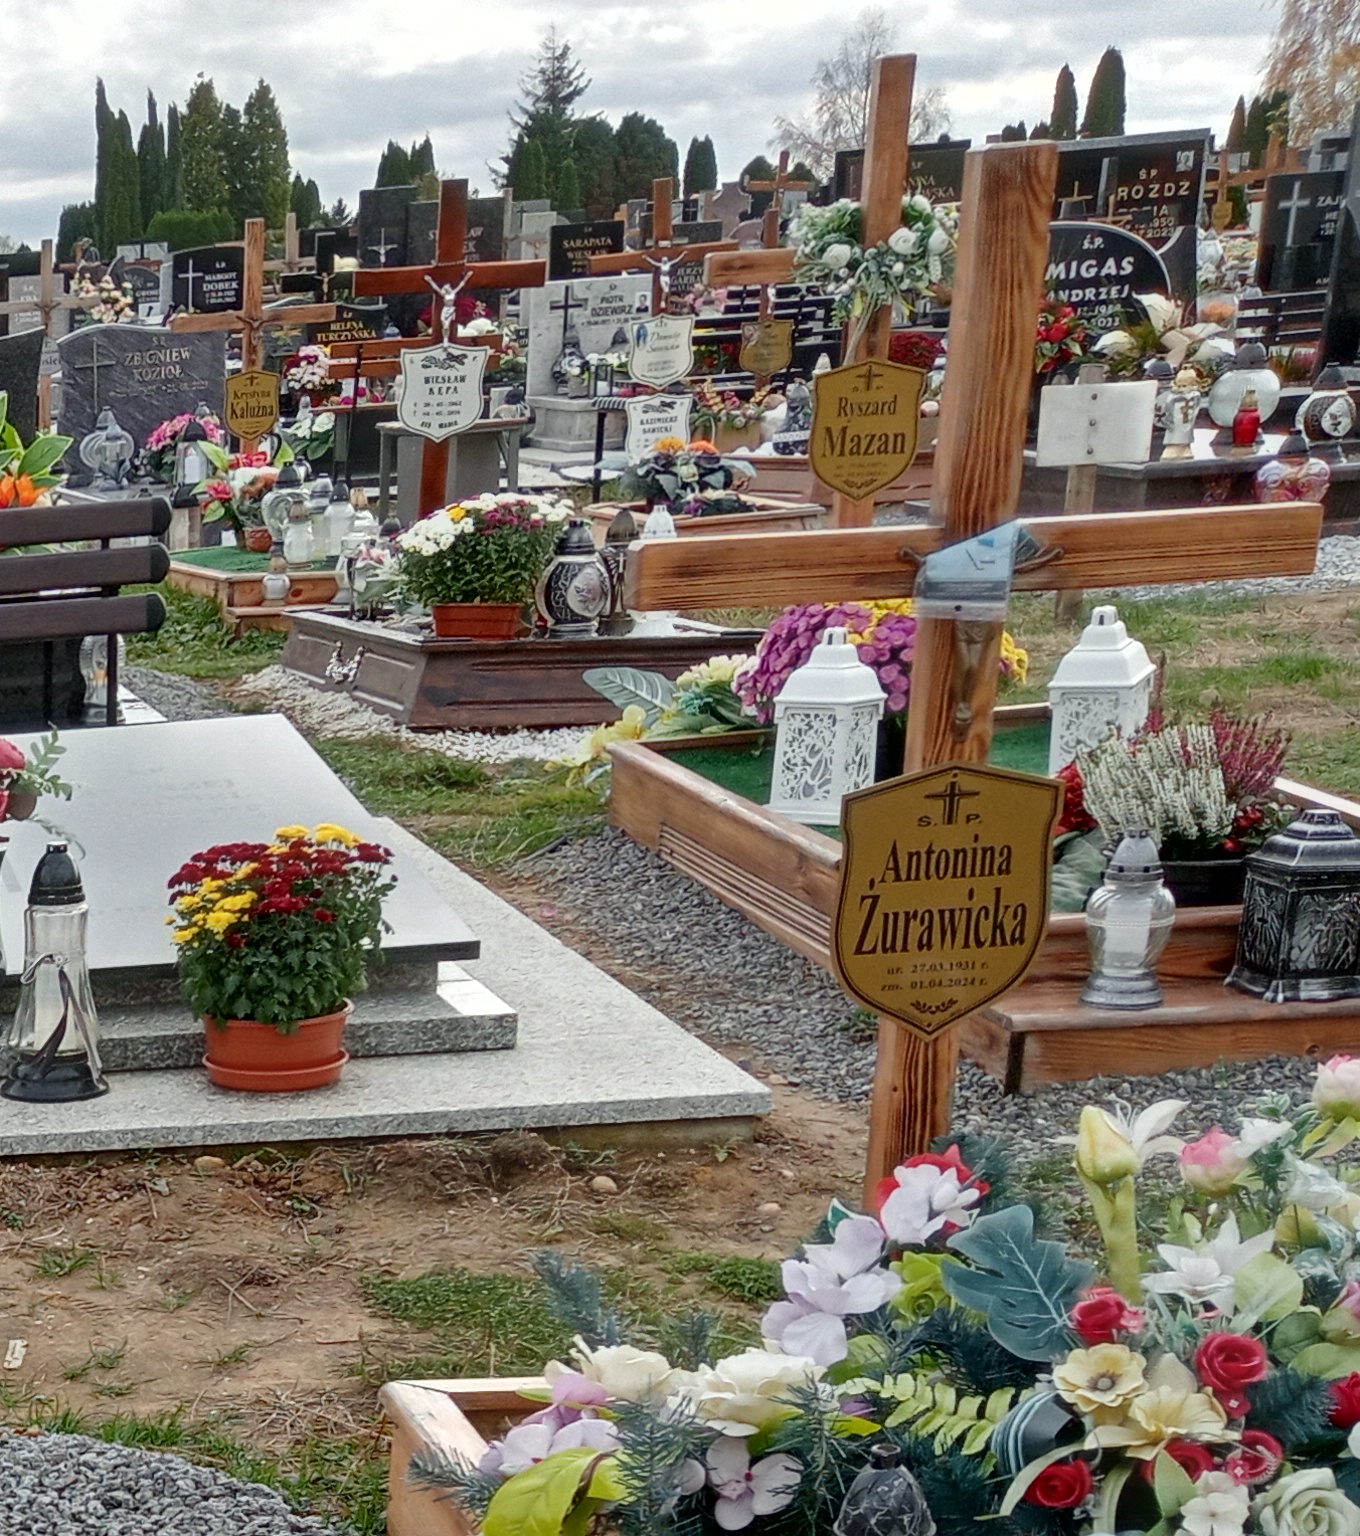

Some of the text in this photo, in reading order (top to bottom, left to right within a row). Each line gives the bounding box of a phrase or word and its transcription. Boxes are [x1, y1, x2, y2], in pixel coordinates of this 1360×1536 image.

[837, 394, 898, 423] Ryszard
[821, 426, 907, 458] Mazan
[878, 833, 1013, 884] Antonina
[853, 877, 1028, 957] Żurawicka
[910, 976, 976, 990] 01.04.2024
